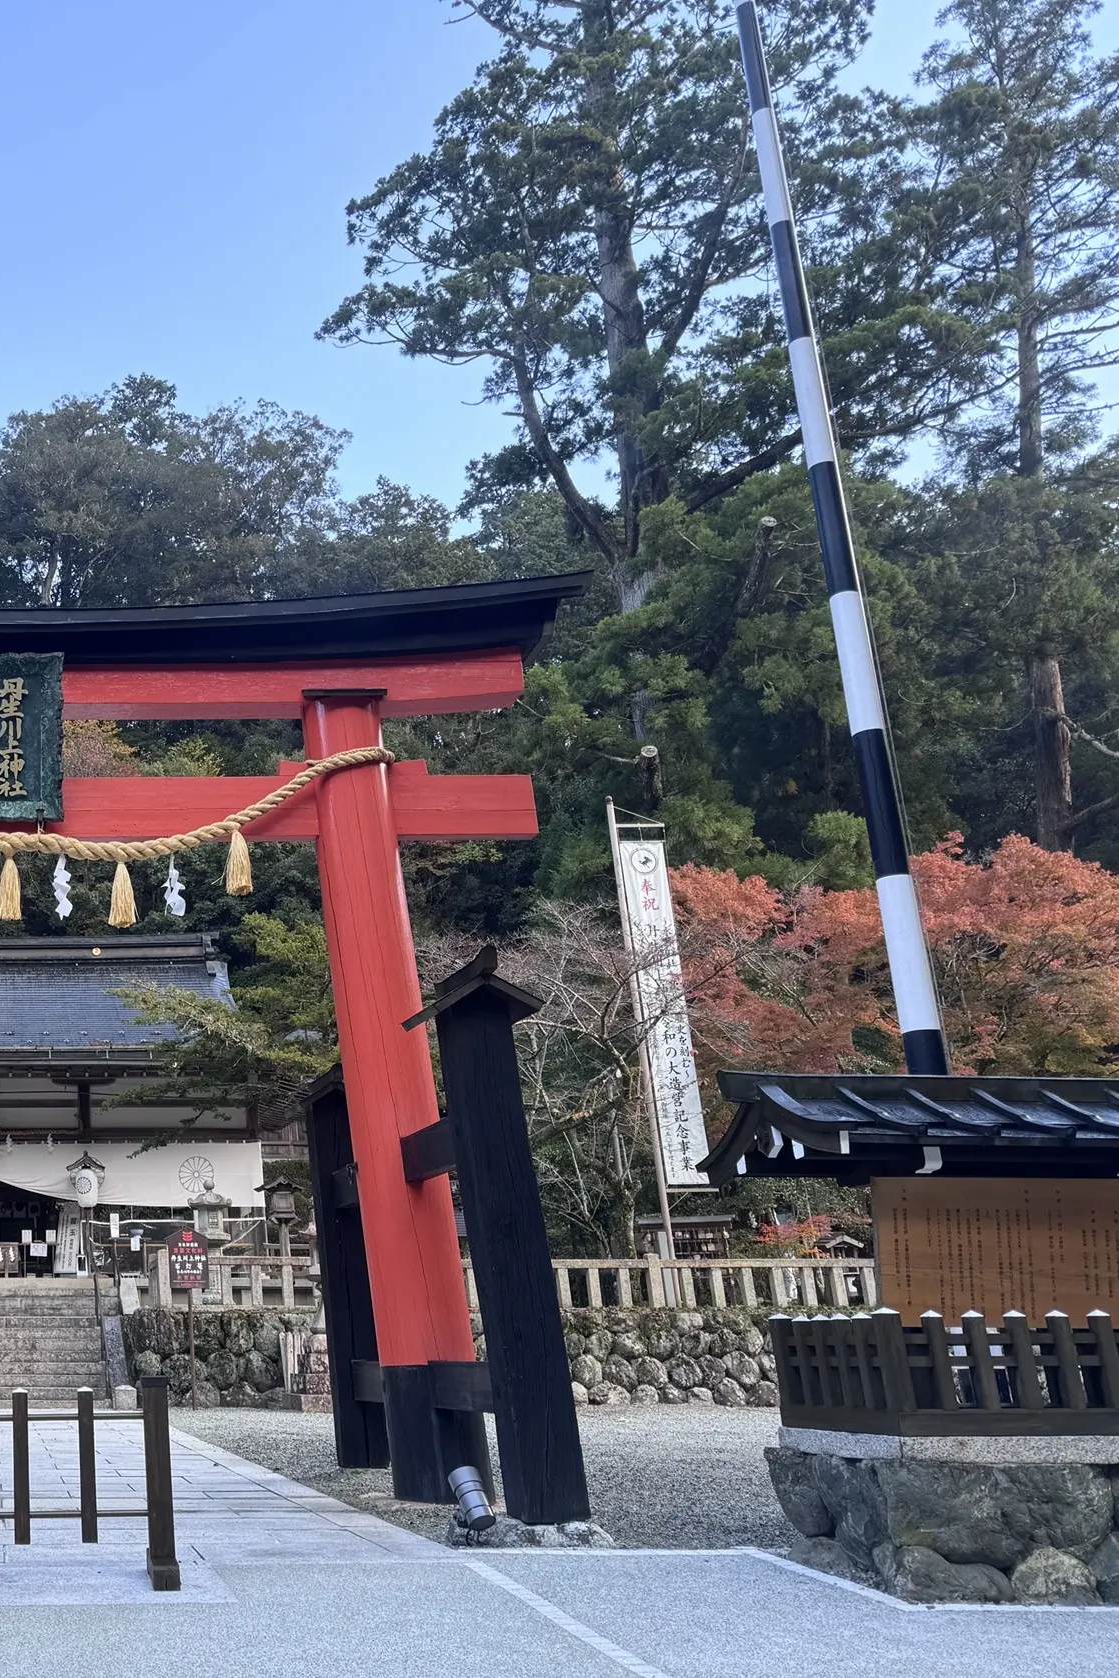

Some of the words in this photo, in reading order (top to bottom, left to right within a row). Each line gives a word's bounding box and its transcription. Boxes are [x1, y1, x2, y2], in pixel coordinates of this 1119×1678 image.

[641, 878, 660, 912] 奉祝
[170, 1254, 207, 1262] 丹生川上神社
